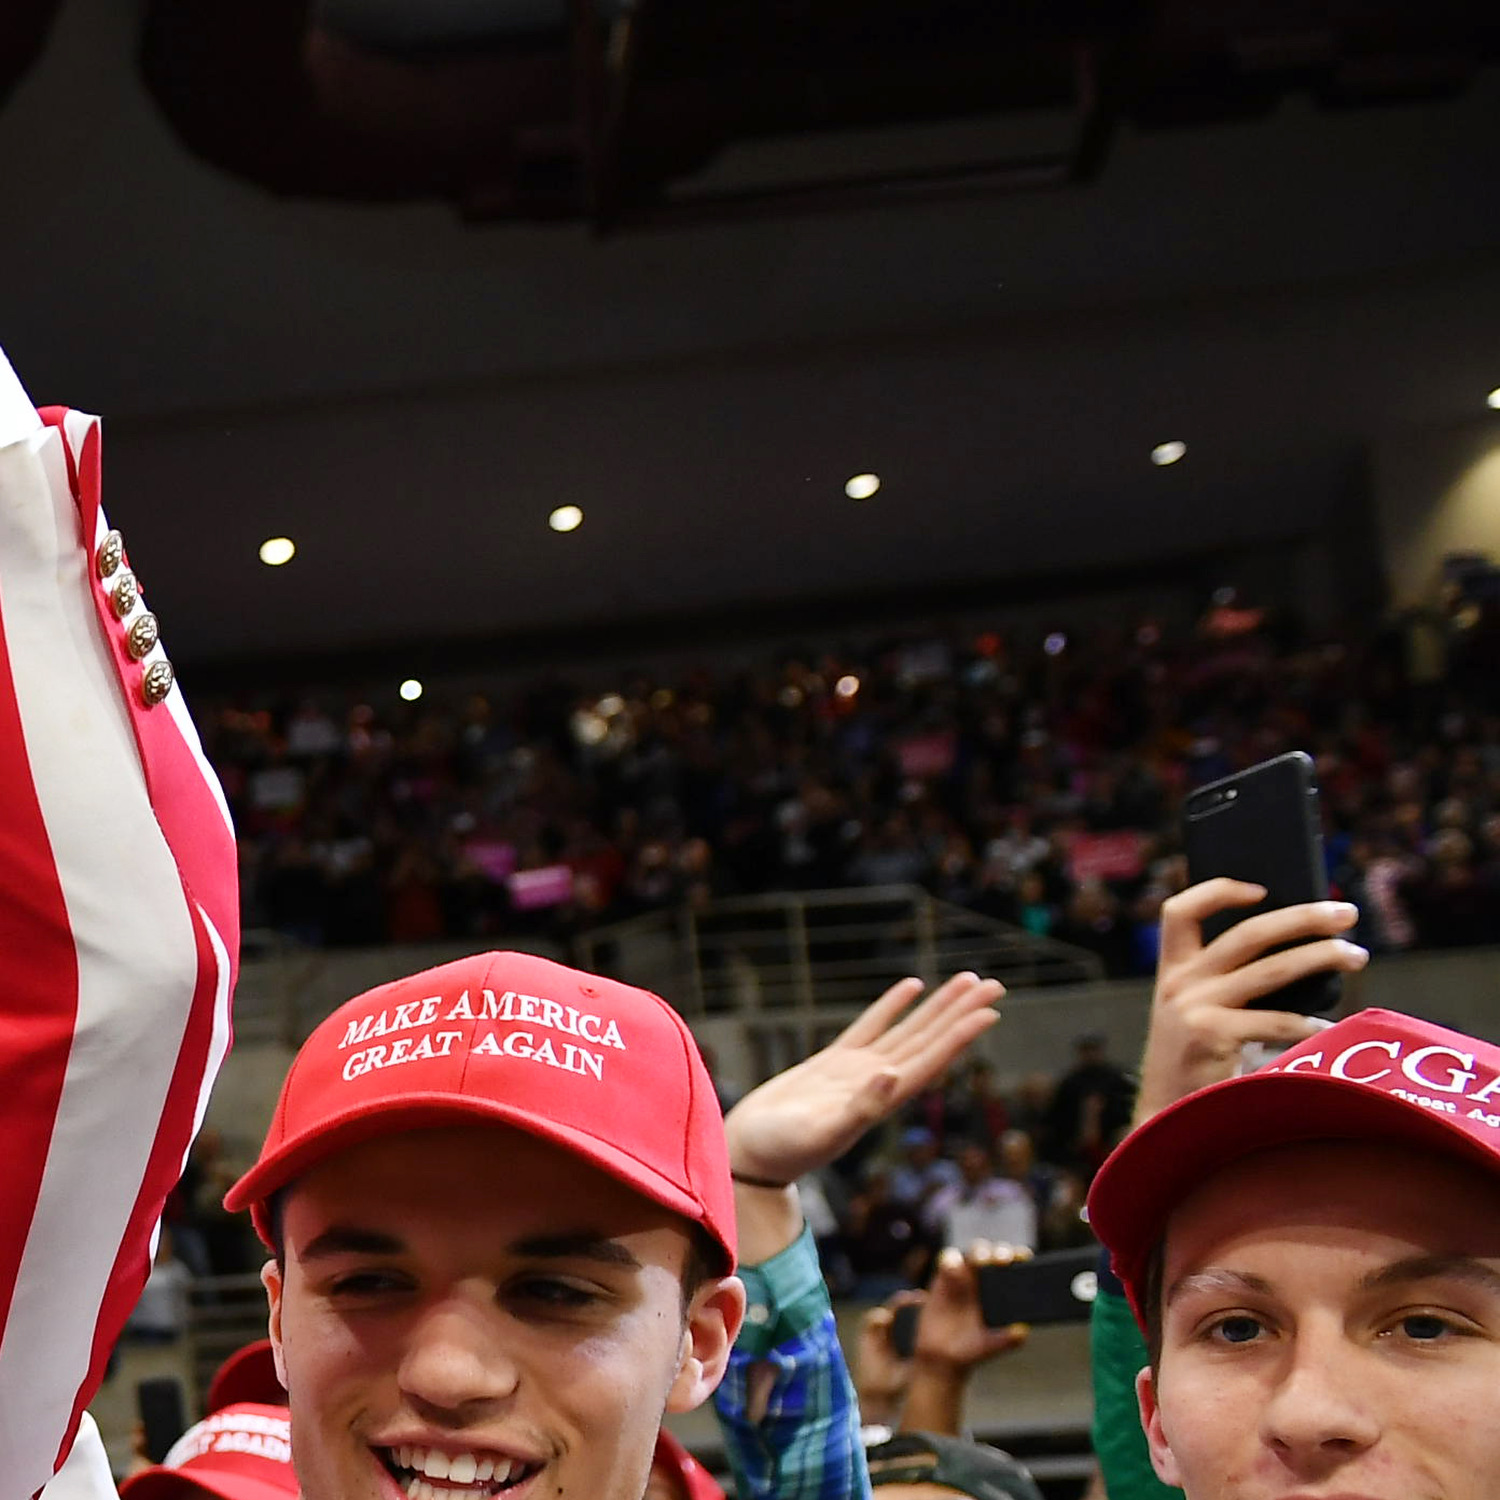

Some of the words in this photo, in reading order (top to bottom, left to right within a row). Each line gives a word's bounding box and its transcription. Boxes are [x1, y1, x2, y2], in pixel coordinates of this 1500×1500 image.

[338, 996, 443, 1050] MAKE
[444, 990, 626, 1050] AMERICA
[342, 1031, 463, 1081] GREAT
[471, 1032, 604, 1081] AGAIN
